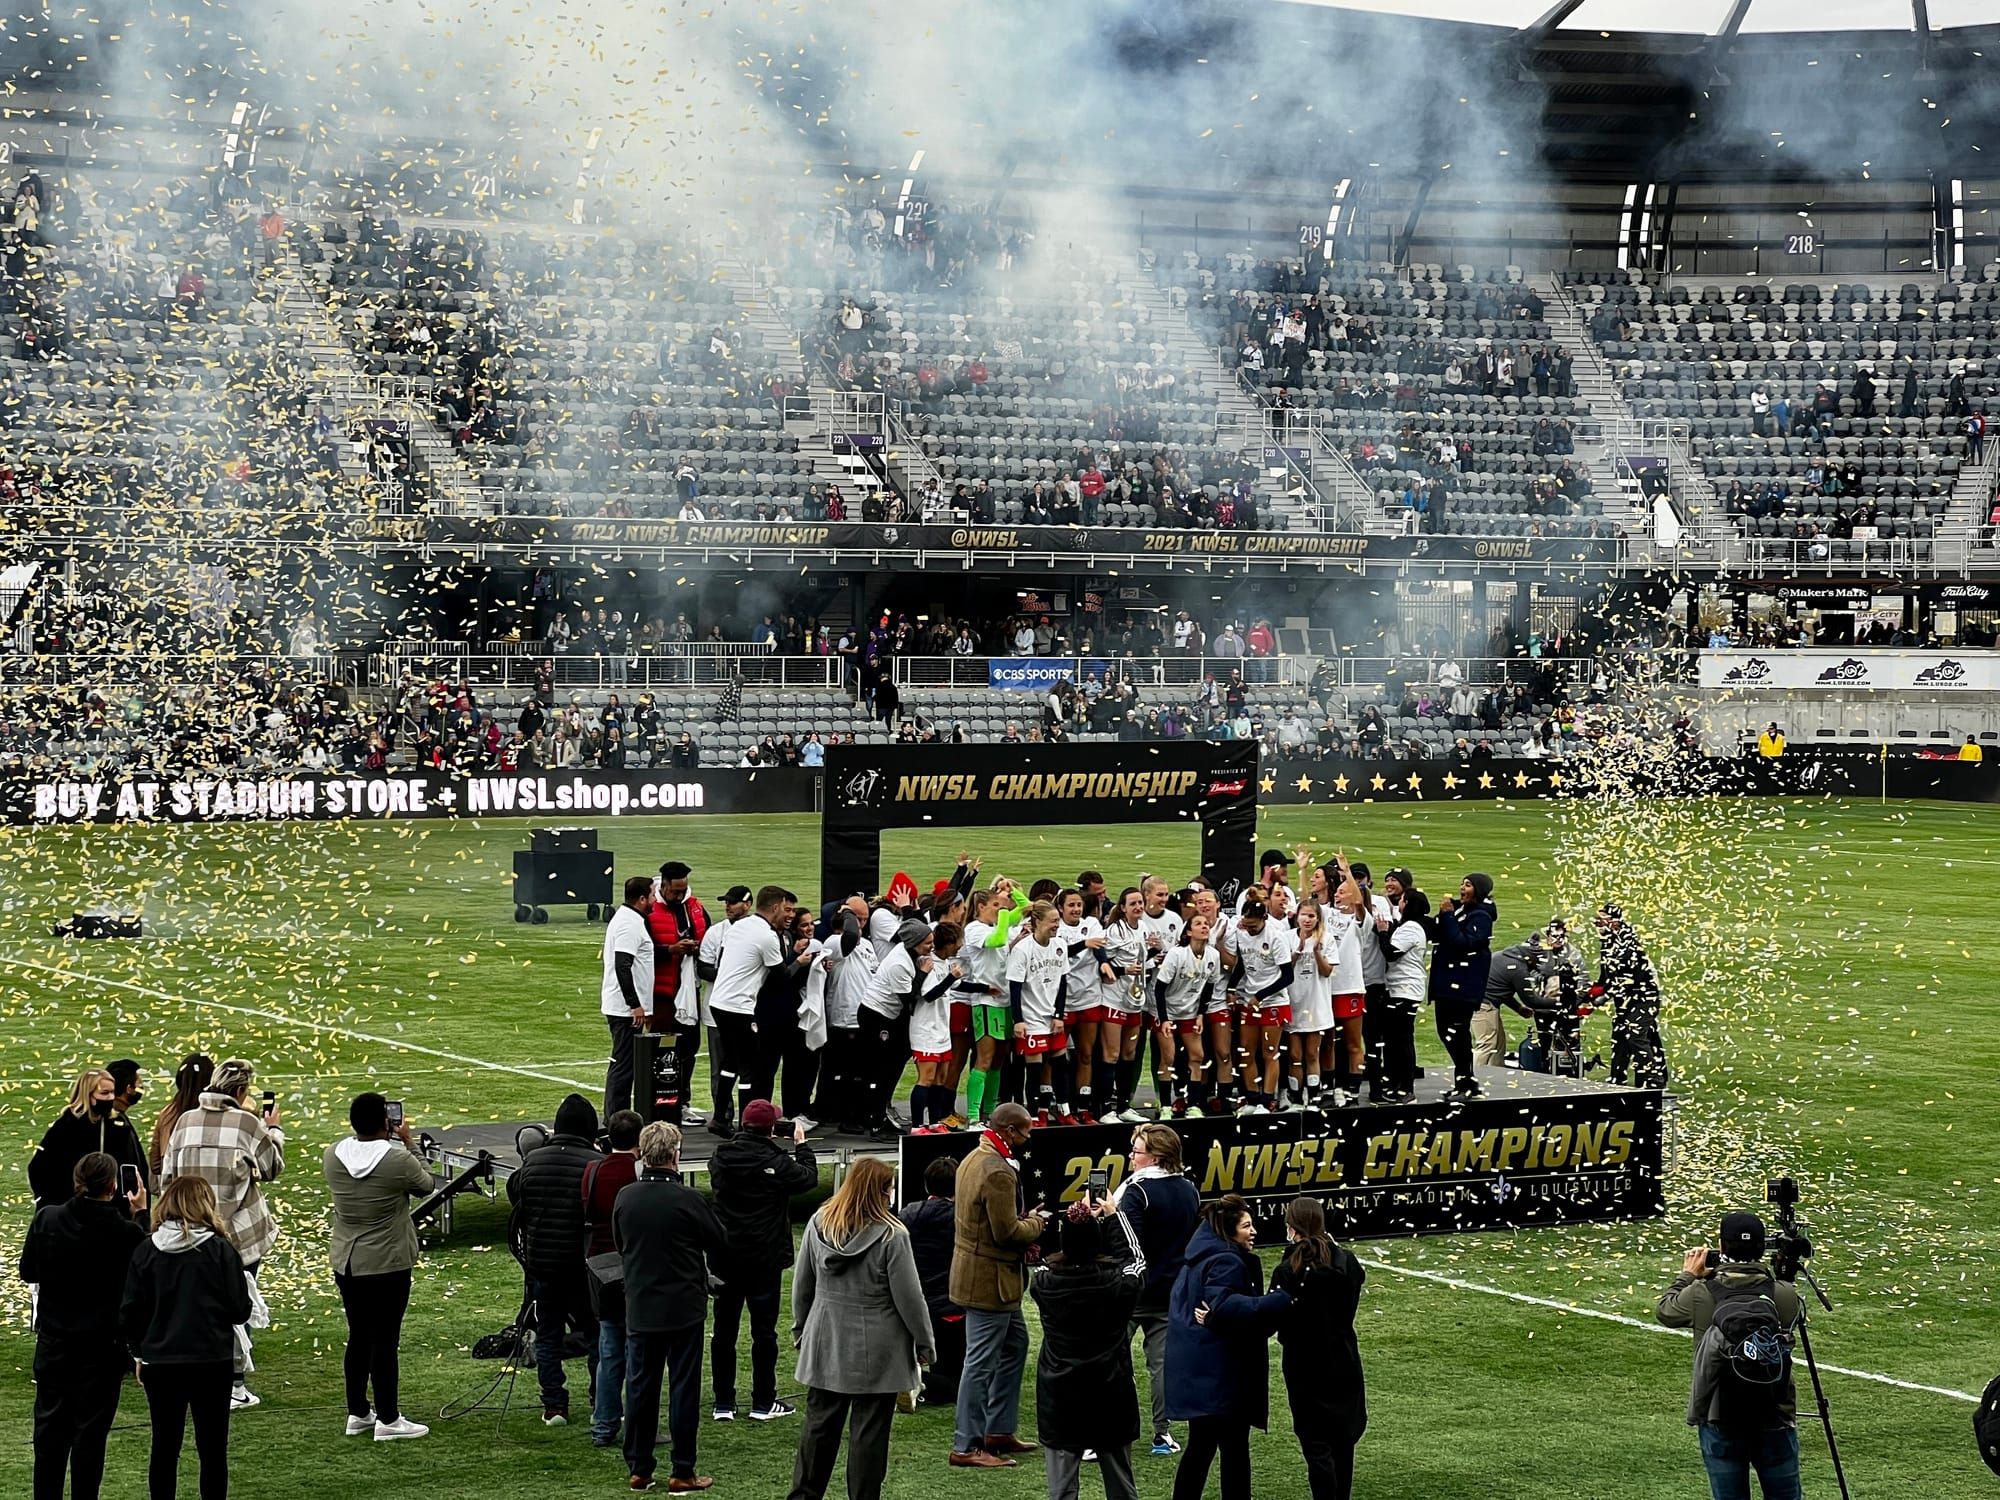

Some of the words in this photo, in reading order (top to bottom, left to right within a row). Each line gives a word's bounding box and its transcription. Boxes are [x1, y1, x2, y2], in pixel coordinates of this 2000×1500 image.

[471, 175, 496, 196] 221
[1300, 225, 1322, 244] 219
[1788, 235, 1813, 254] 218
[571, 523, 617, 541] 2021
[624, 524, 680, 543] NWSL
[686, 526, 830, 545] CHAMPIONSHIP
[951, 528, 1019, 549] @NWSL
[1144, 534, 1184, 551] 2021
[1190, 535, 1239, 552] NWSL
[1245, 537, 1369, 554] CHAMPIONSHIP
[1474, 540, 1533, 558] @NWSL
[1789, 588, 1835, 598] Maker's
[1835, 588, 1869, 598] Mark
[1940, 585, 1966, 598] Falls
[1966, 584, 1990, 600] City
[1002, 668, 1026, 681] CBS
[1026, 668, 1073, 681] SPORTS
[895, 774, 979, 802] NWSL
[989, 770, 1198, 801] CHAMPIONSHIP
[36, 782, 105, 818] BUY
[116, 781, 159, 817] AT
[172, 779, 314, 816] STADIUM
[326, 779, 427, 814] STORE
[468, 777, 704, 816] NWSLshop.com
[1027, 1034, 1036, 1049] 6
[1200, 1137, 1345, 1192] NWSL
[1363, 1120, 1635, 1180] CHAMPIONS
[1257, 1202, 1290, 1217] LYN
[1392, 1188, 1472, 1206] STADIUM
[1530, 1178, 1632, 1197] LOUISVILLE
